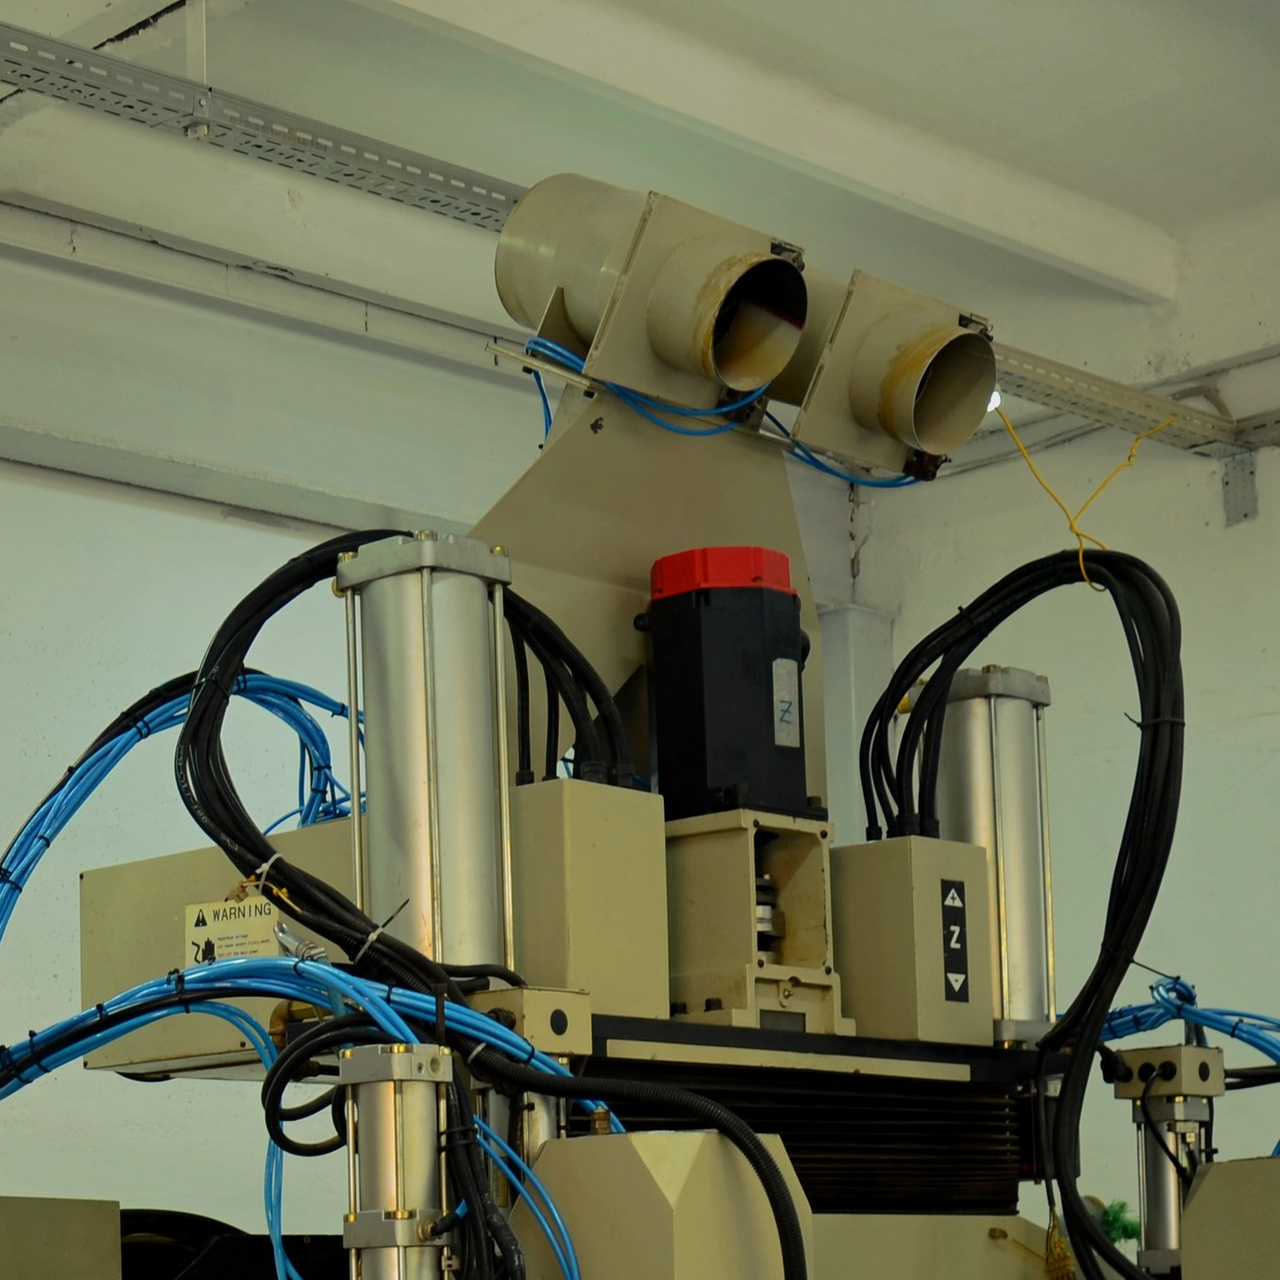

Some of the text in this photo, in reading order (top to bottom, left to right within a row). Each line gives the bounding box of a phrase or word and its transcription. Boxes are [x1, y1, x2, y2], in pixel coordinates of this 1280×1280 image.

[779, 700, 793, 724] Z
[213, 903, 272, 921] WARNING
[949, 925, 962, 949] Z
